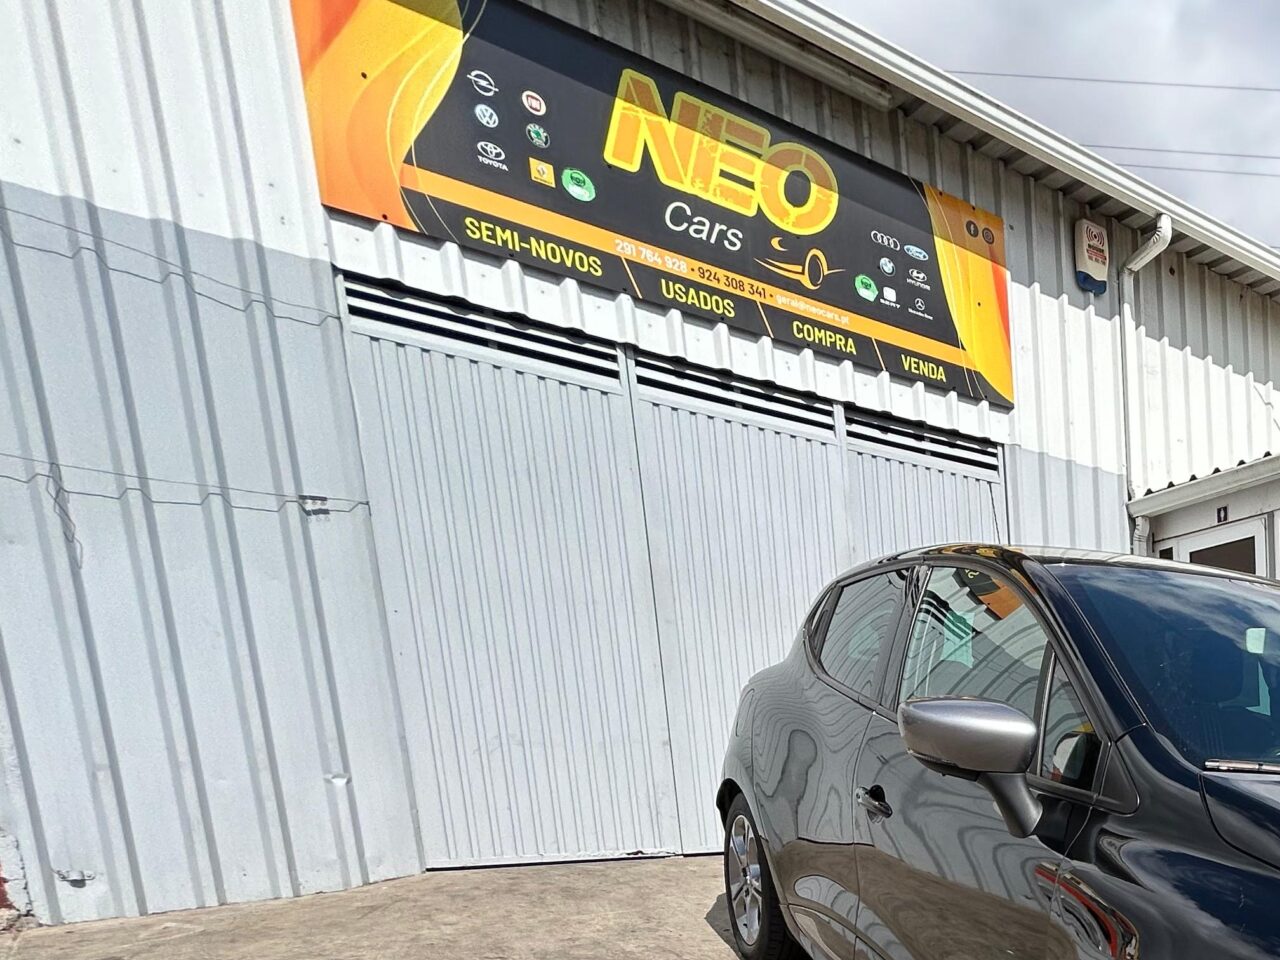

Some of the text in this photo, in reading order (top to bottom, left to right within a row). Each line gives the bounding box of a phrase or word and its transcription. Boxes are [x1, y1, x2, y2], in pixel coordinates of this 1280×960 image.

[477, 155, 509, 171] TOYOTA
[603, 68, 838, 236] NEO
[464, 216, 603, 277] SEMI-NOVOS
[664, 201, 743, 251] Cars
[614, 239, 637, 257] 291
[638, 246, 662, 265] 764
[664, 255, 688, 274] 928
[697, 266, 721, 284] 924
[723, 274, 745, 292] 308
[748, 282, 767, 299] 341
[661, 278, 735, 318] USADOS
[792, 321, 857, 355] COMPRA
[901, 353, 946, 383] VENDA
